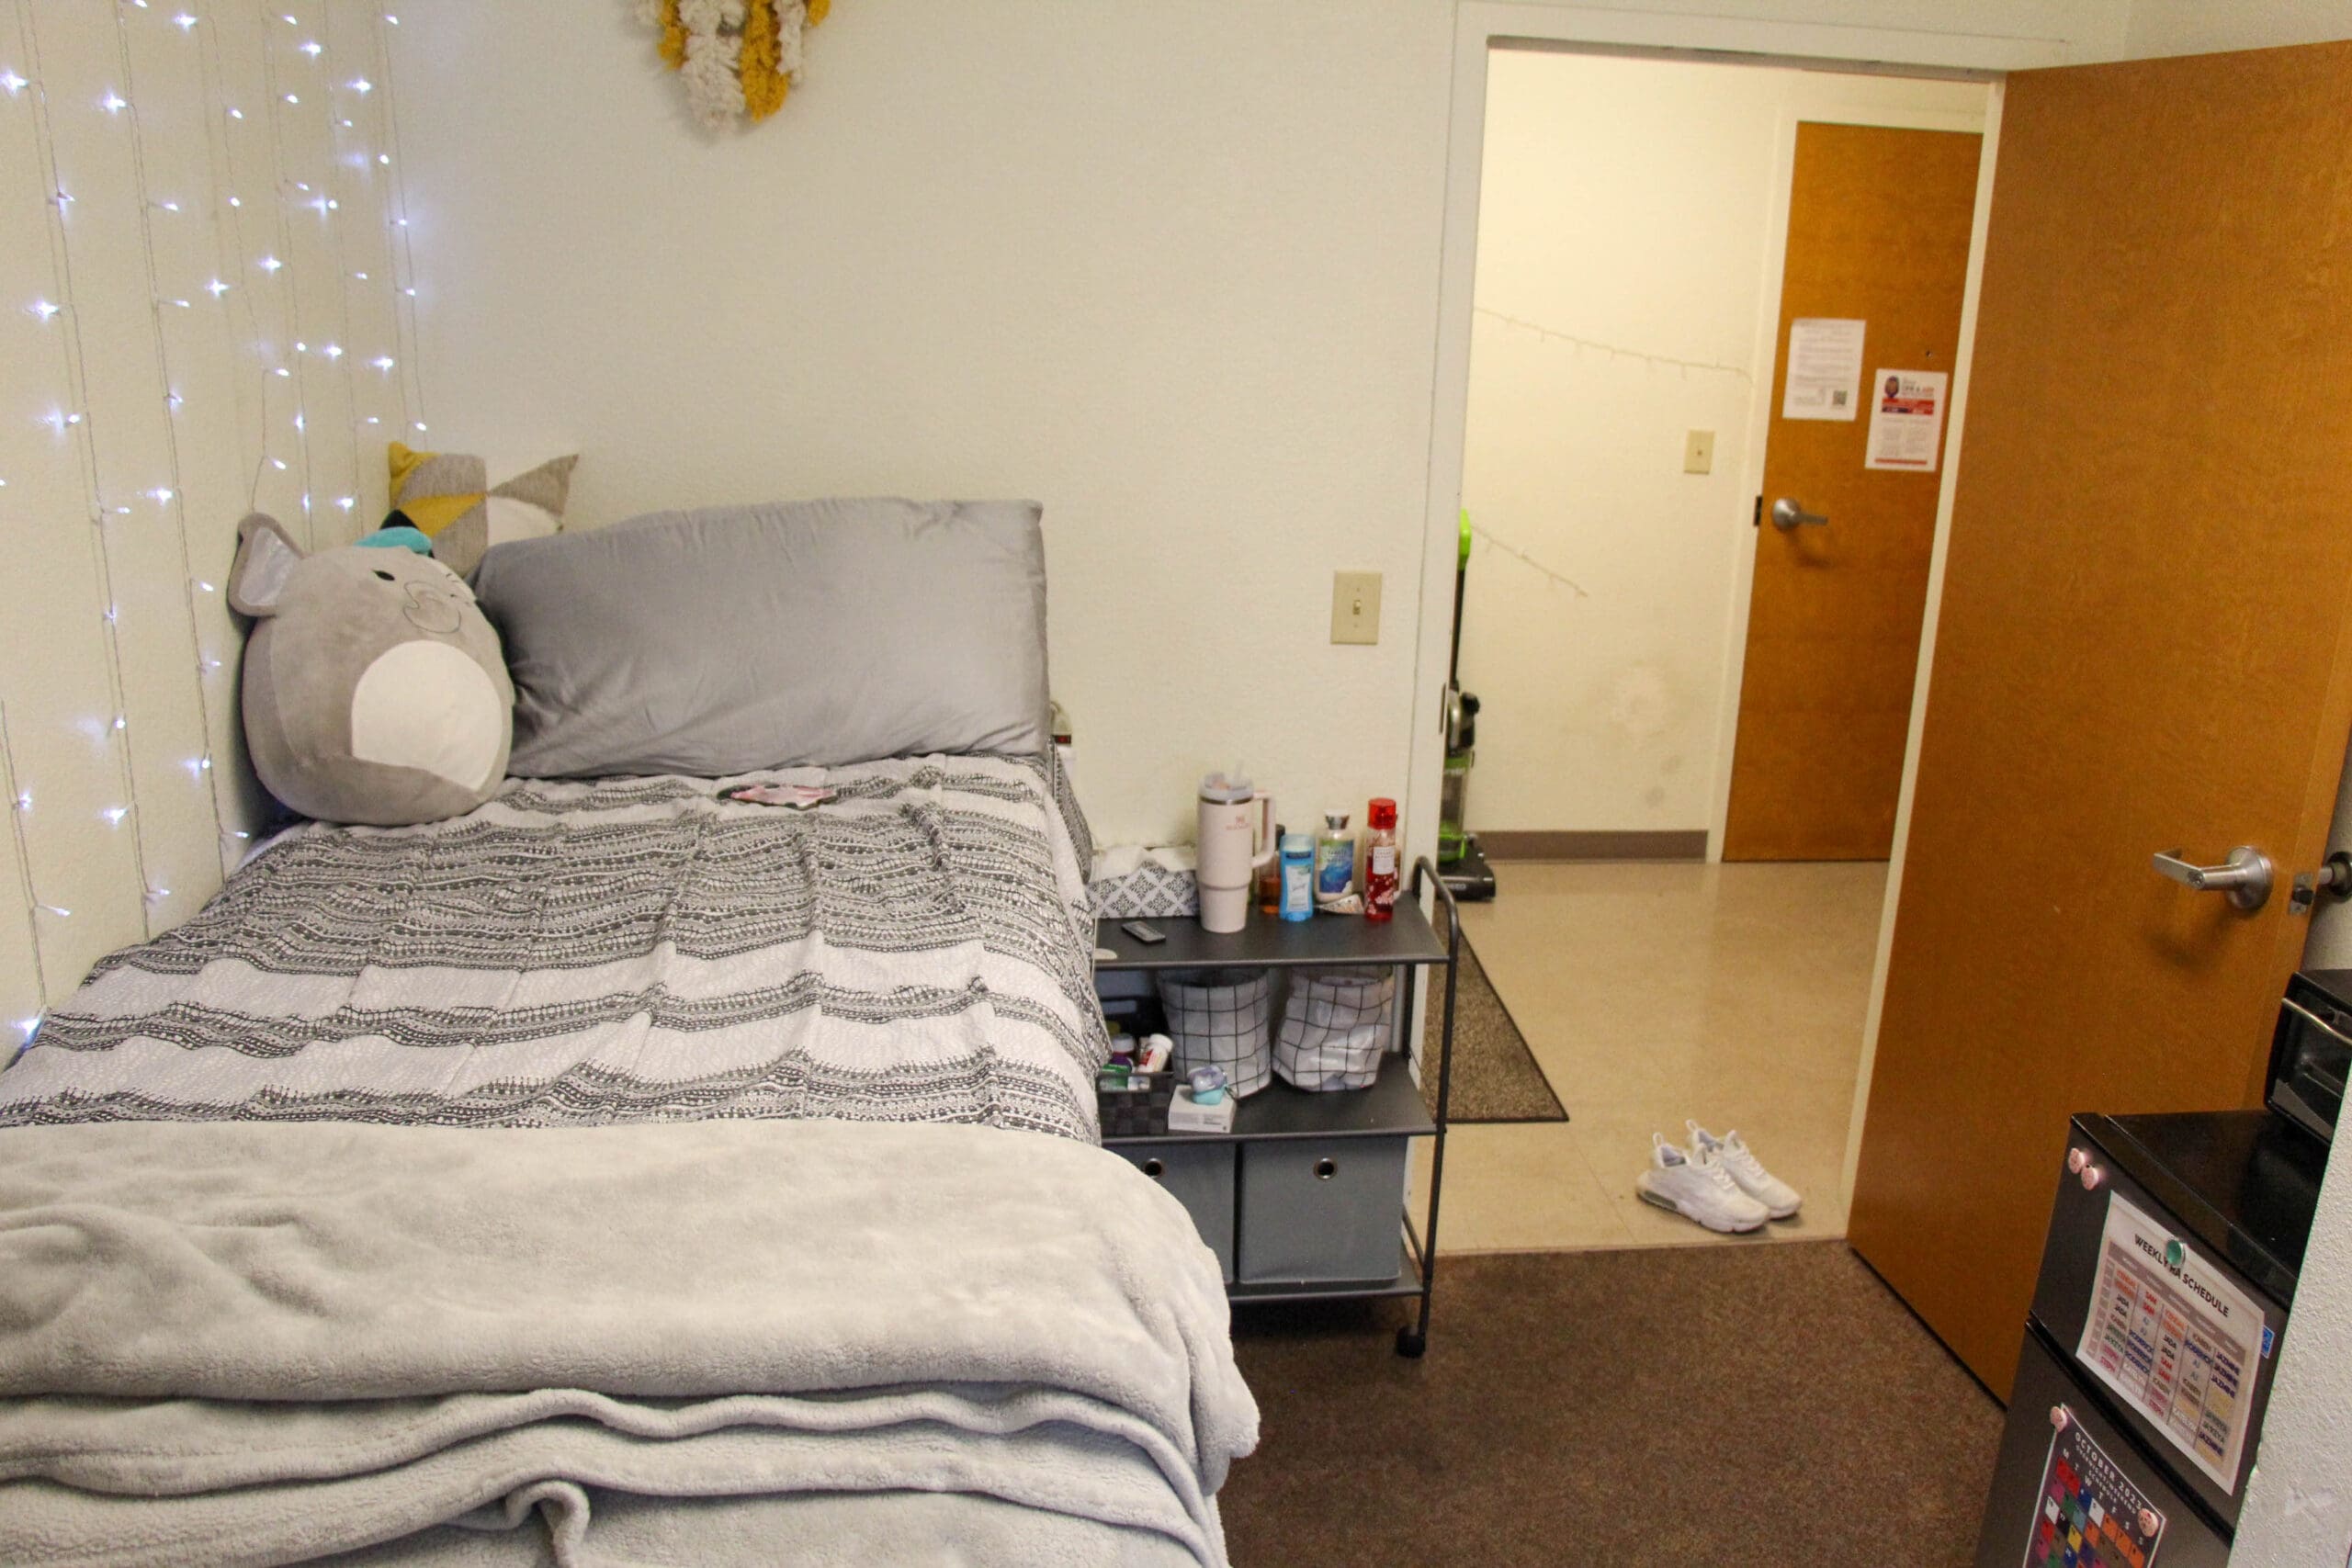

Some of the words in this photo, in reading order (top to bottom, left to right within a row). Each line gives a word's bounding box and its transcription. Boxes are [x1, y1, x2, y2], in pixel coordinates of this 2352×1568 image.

[2134, 1233, 2168, 1269] WEEKLY
[2182, 1272, 2229, 1318] SCHEDULE
[2074, 1430, 2116, 1482] OCTOBER
[2118, 1481, 2142, 1510] 2023
